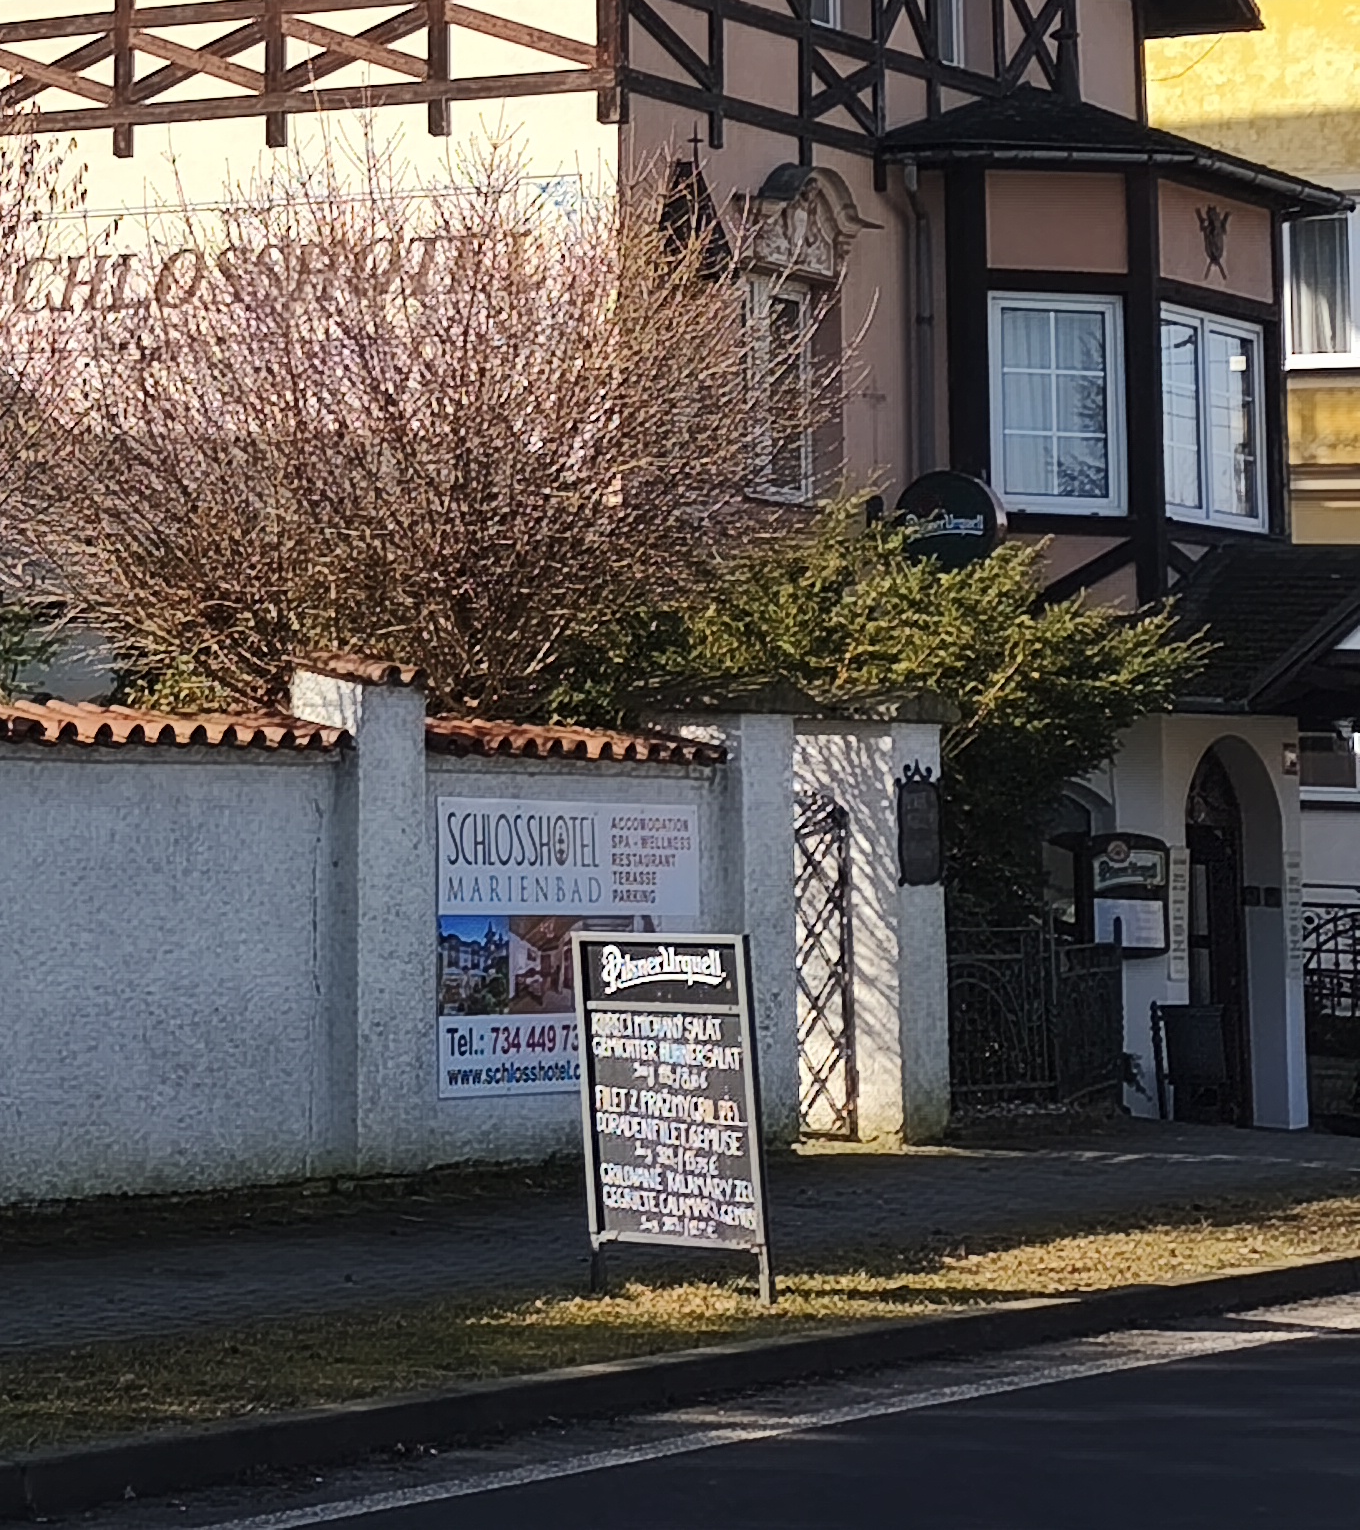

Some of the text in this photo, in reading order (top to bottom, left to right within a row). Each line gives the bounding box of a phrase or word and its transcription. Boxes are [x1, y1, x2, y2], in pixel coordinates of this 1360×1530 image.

[446, 812, 599, 868] SCHLOSSHOTEL
[611, 834, 631, 849] SPA
[641, 835, 691, 850] WELLNESS
[611, 852, 676, 867] RESTAURANT
[447, 875, 602, 903] MARIENBAD
[612, 871, 657, 885] TERASSE
[612, 889, 656, 904] PARKING
[601, 945, 726, 994] Pilsner Urquell
[446, 1024, 579, 1056] Tel.: 734 449 73
[447, 1060, 581, 1085] www.schlosshotel.c
[595, 1085, 627, 1112] FILET
